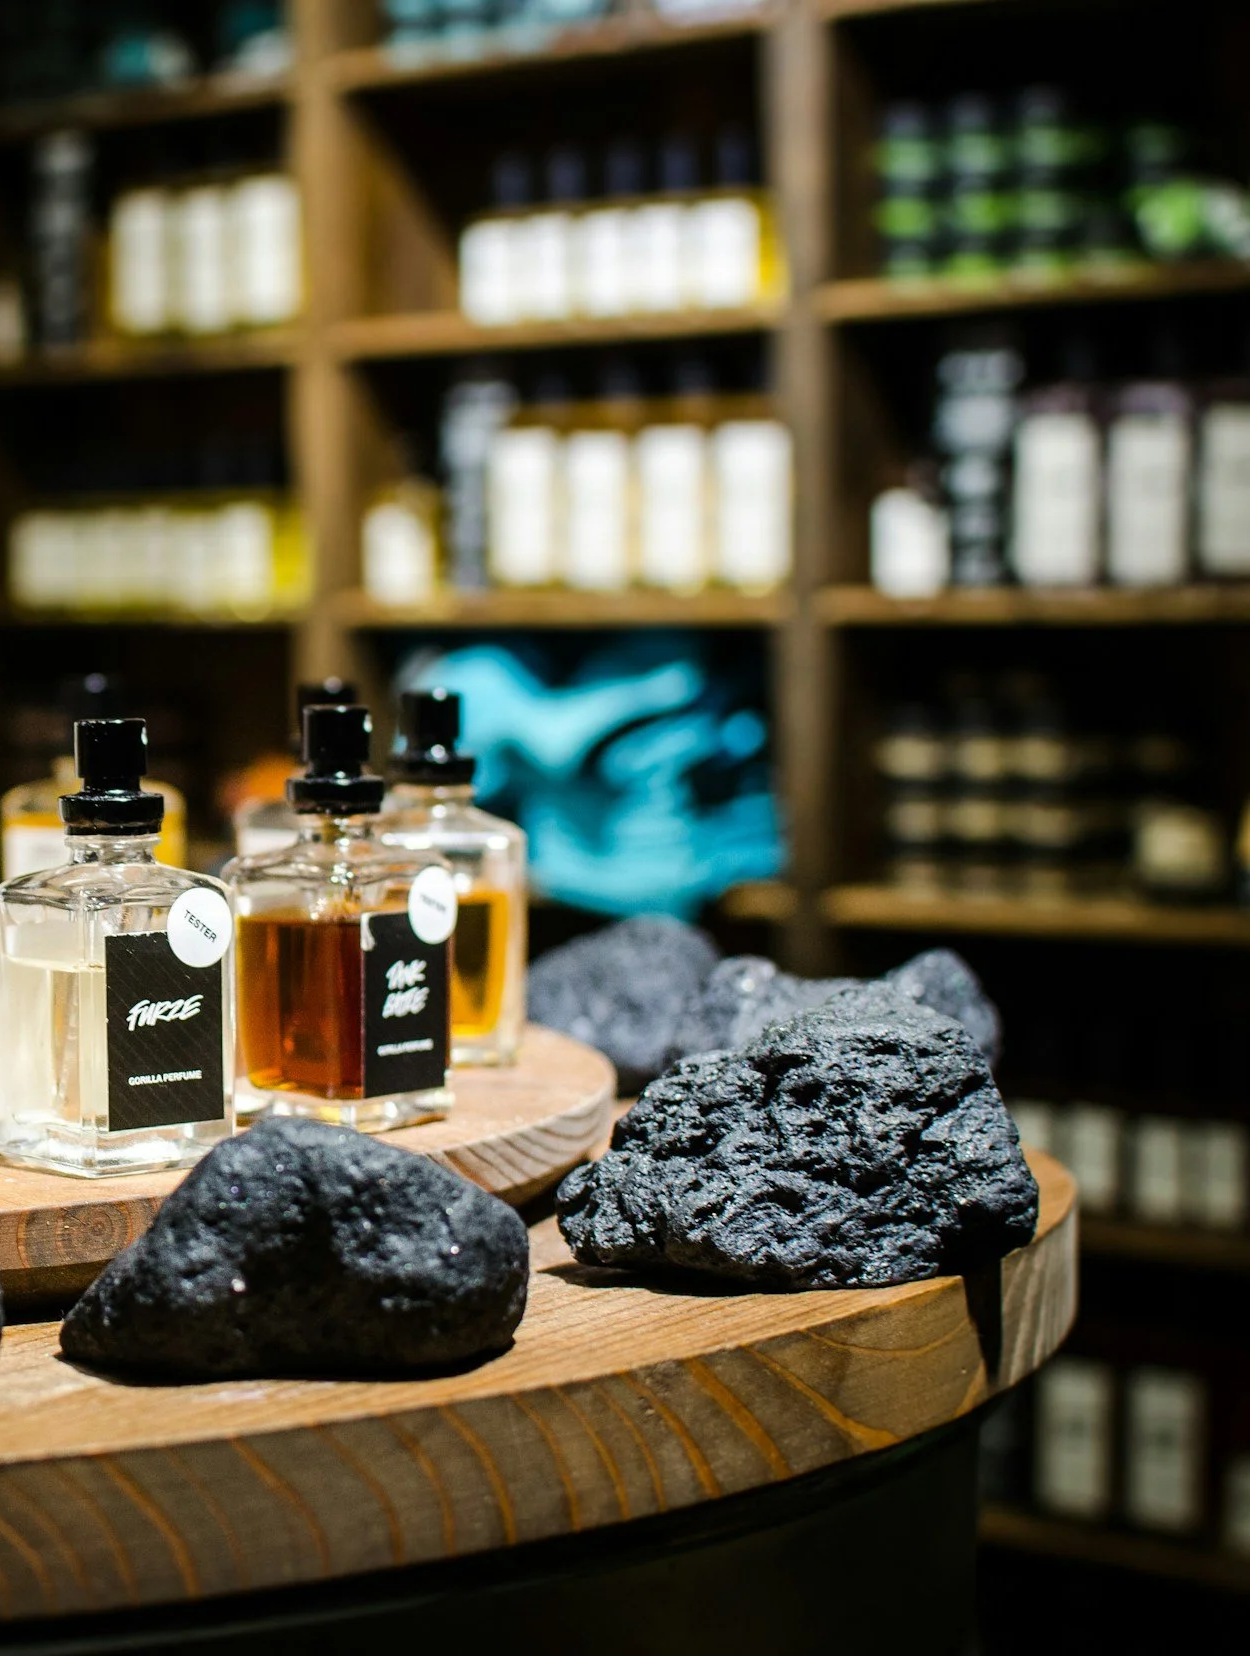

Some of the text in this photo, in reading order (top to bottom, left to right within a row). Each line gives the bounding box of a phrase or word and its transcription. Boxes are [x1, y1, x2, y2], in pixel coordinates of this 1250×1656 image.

[182, 909, 217, 943] TESTER
[126, 994, 204, 1032] FURZE
[128, 1070, 202, 1086] GORILLA PERFUME
